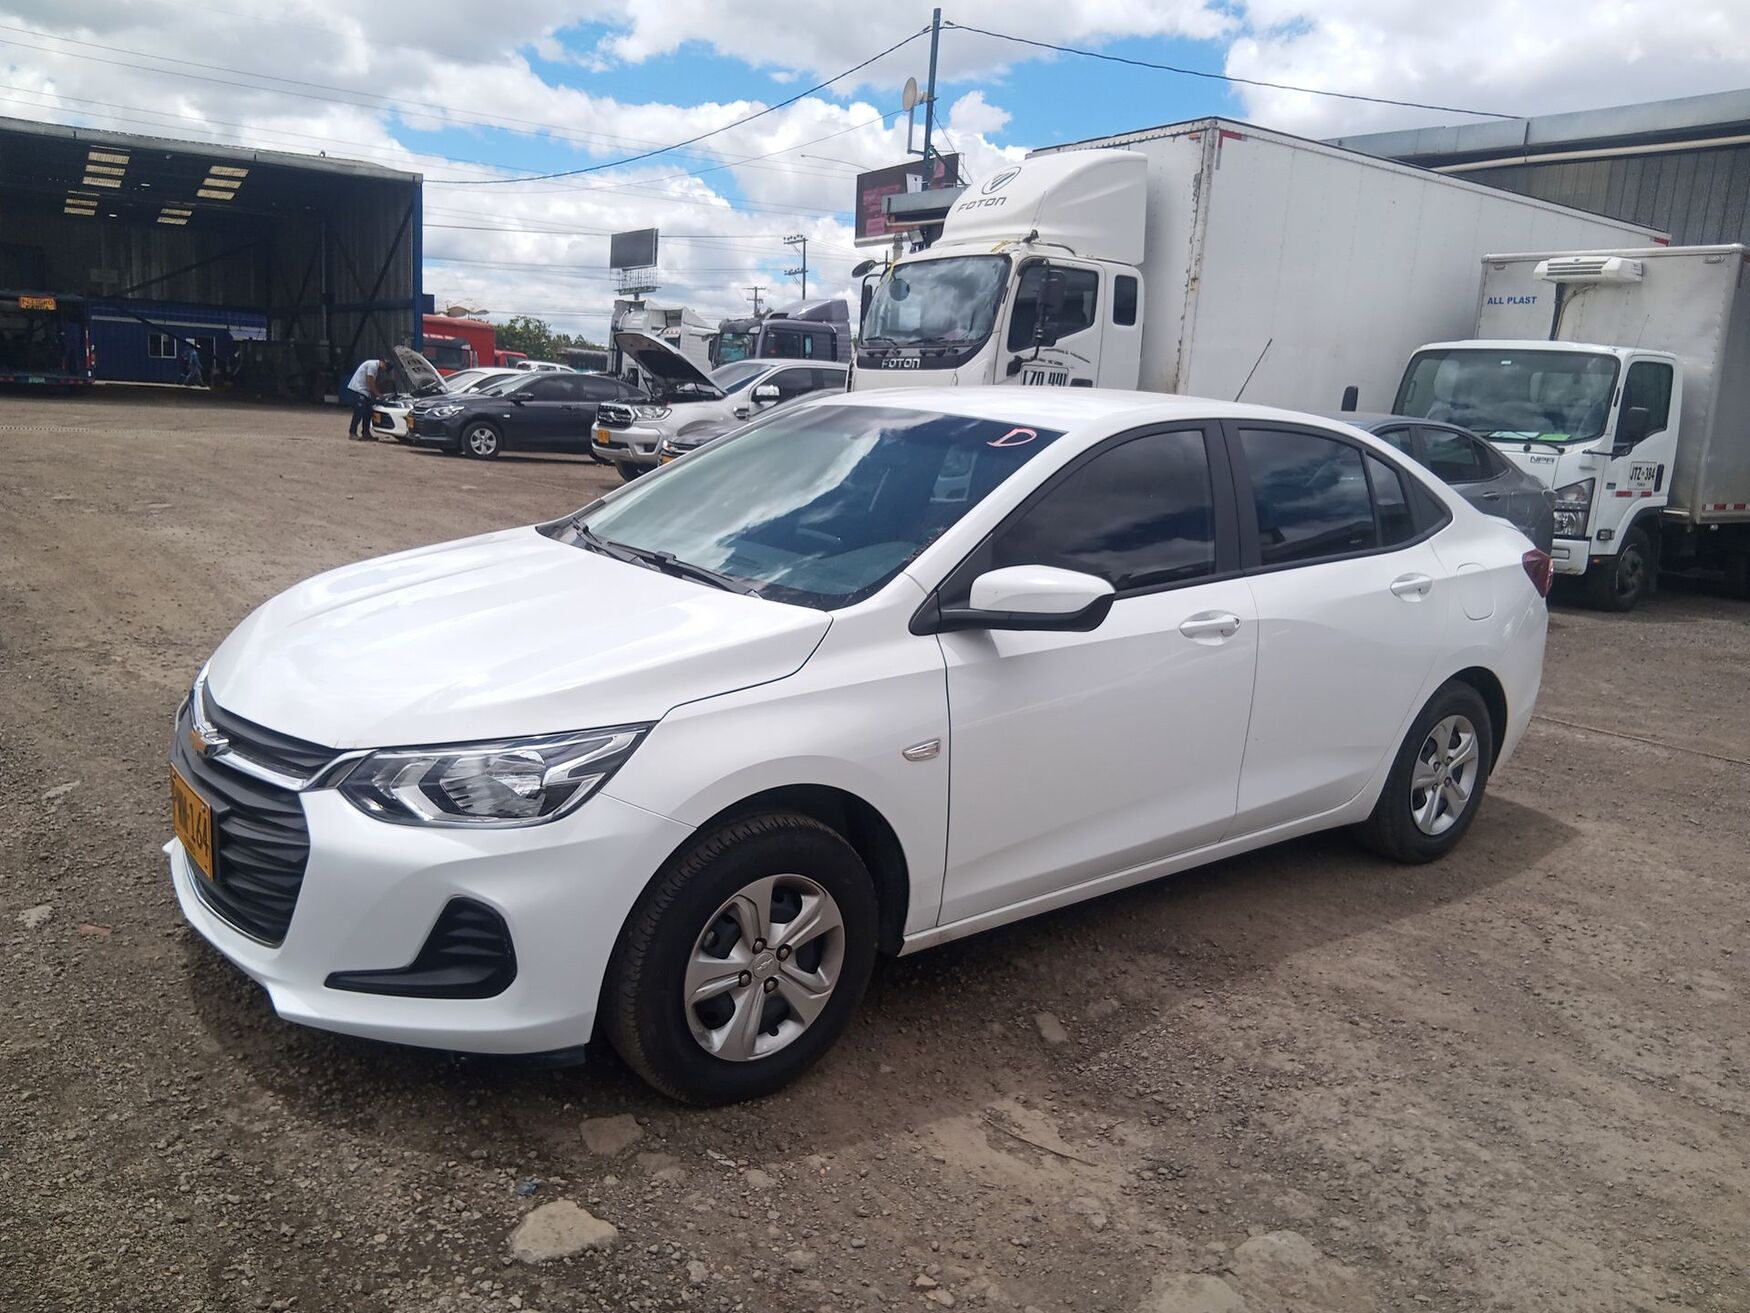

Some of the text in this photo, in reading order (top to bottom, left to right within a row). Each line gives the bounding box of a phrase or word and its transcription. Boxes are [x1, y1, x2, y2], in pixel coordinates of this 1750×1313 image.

[957, 197, 1007, 212] FOTON
[1487, 296, 1537, 305] ALL PLAST
[881, 358, 921, 369] FOTON
[986, 428, 1037, 447] D
